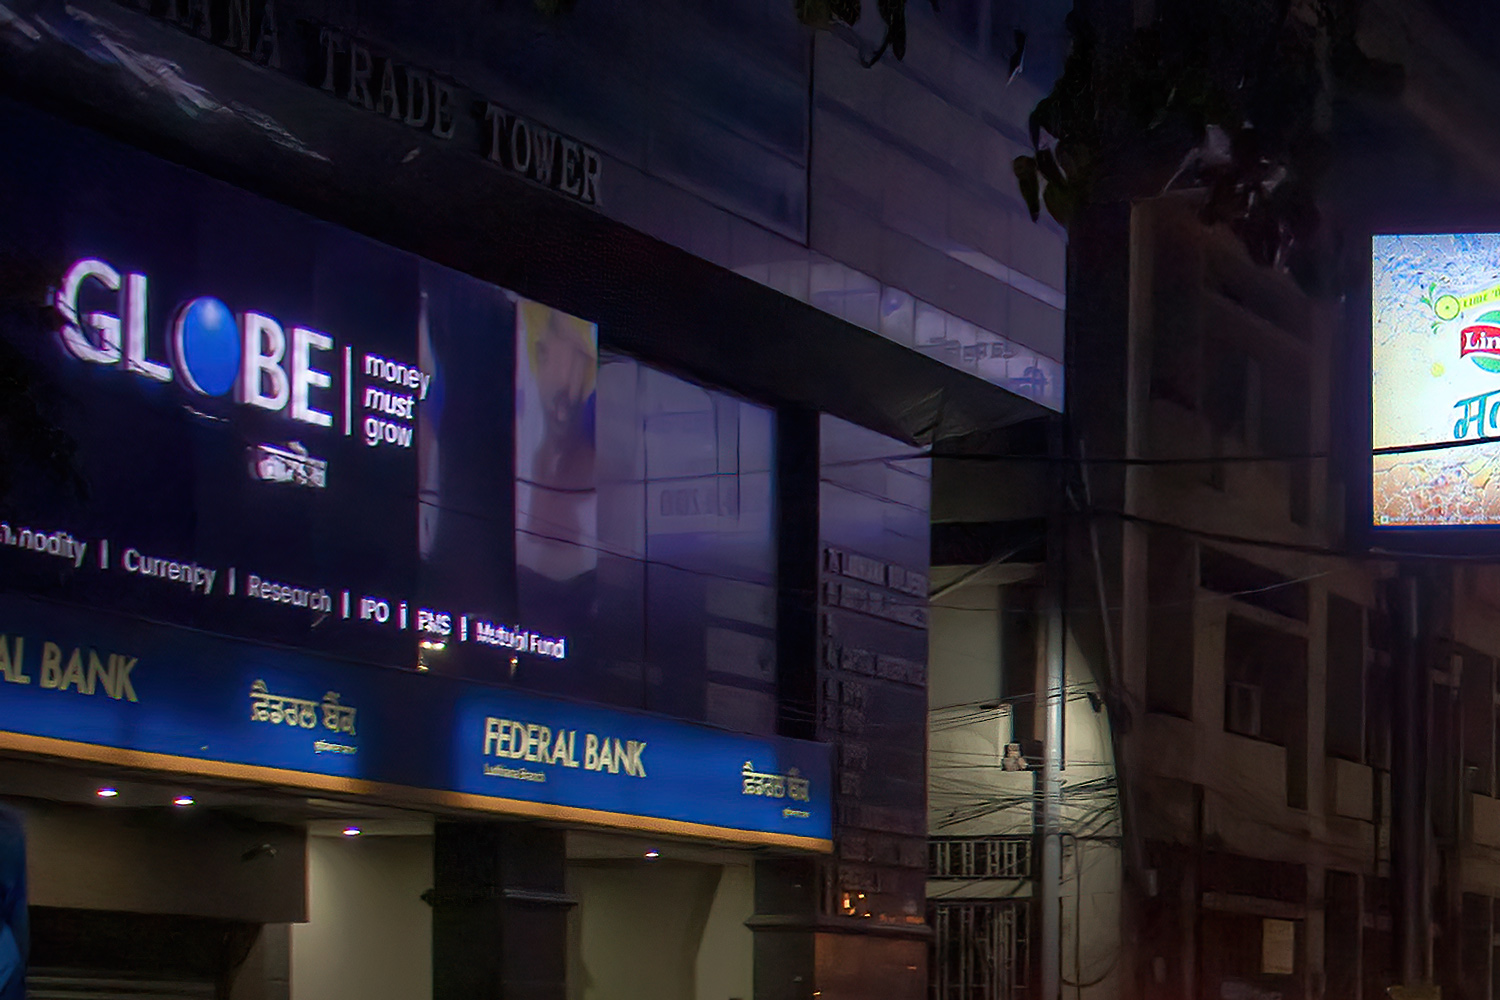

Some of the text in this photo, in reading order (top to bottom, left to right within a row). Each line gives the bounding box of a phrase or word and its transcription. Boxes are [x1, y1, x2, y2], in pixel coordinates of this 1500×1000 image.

[318, 27, 456, 140] TRADE
[484, 100, 601, 205] TOWER
[56, 258, 334, 427] GLOBE
[365, 353, 431, 400] money
[364, 387, 415, 420] must
[364, 416, 414, 448] grow
[122, 547, 217, 595] Currency
[248, 574, 332, 613] Research
[361, 596, 390, 623] IPO
[530, 633, 565, 659] Fund
[40, 641, 139, 703] BANK
[483, 716, 647, 778] FEDERAL BANK
